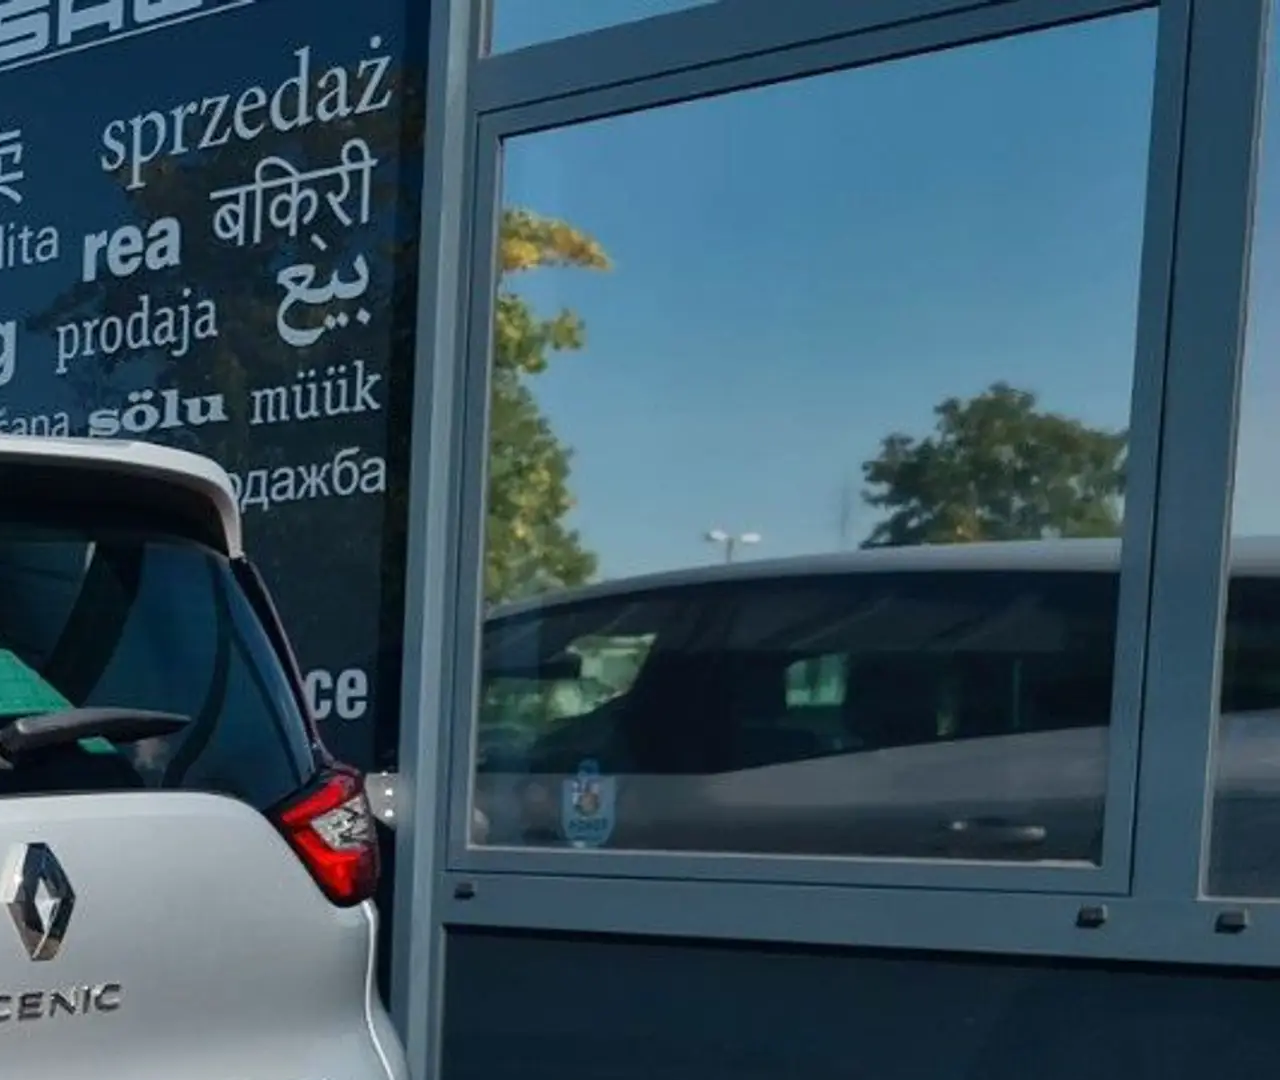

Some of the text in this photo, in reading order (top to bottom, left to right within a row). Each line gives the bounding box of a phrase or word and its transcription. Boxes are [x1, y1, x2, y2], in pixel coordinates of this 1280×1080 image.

[100, 35, 393, 191] sprzedaż
[81, 216, 181, 283] rea
[55, 288, 218, 374] prodaja
[276, 254, 372, 347] بيع
[88, 387, 228, 438] sölu
[249, 360, 382, 425] müük
